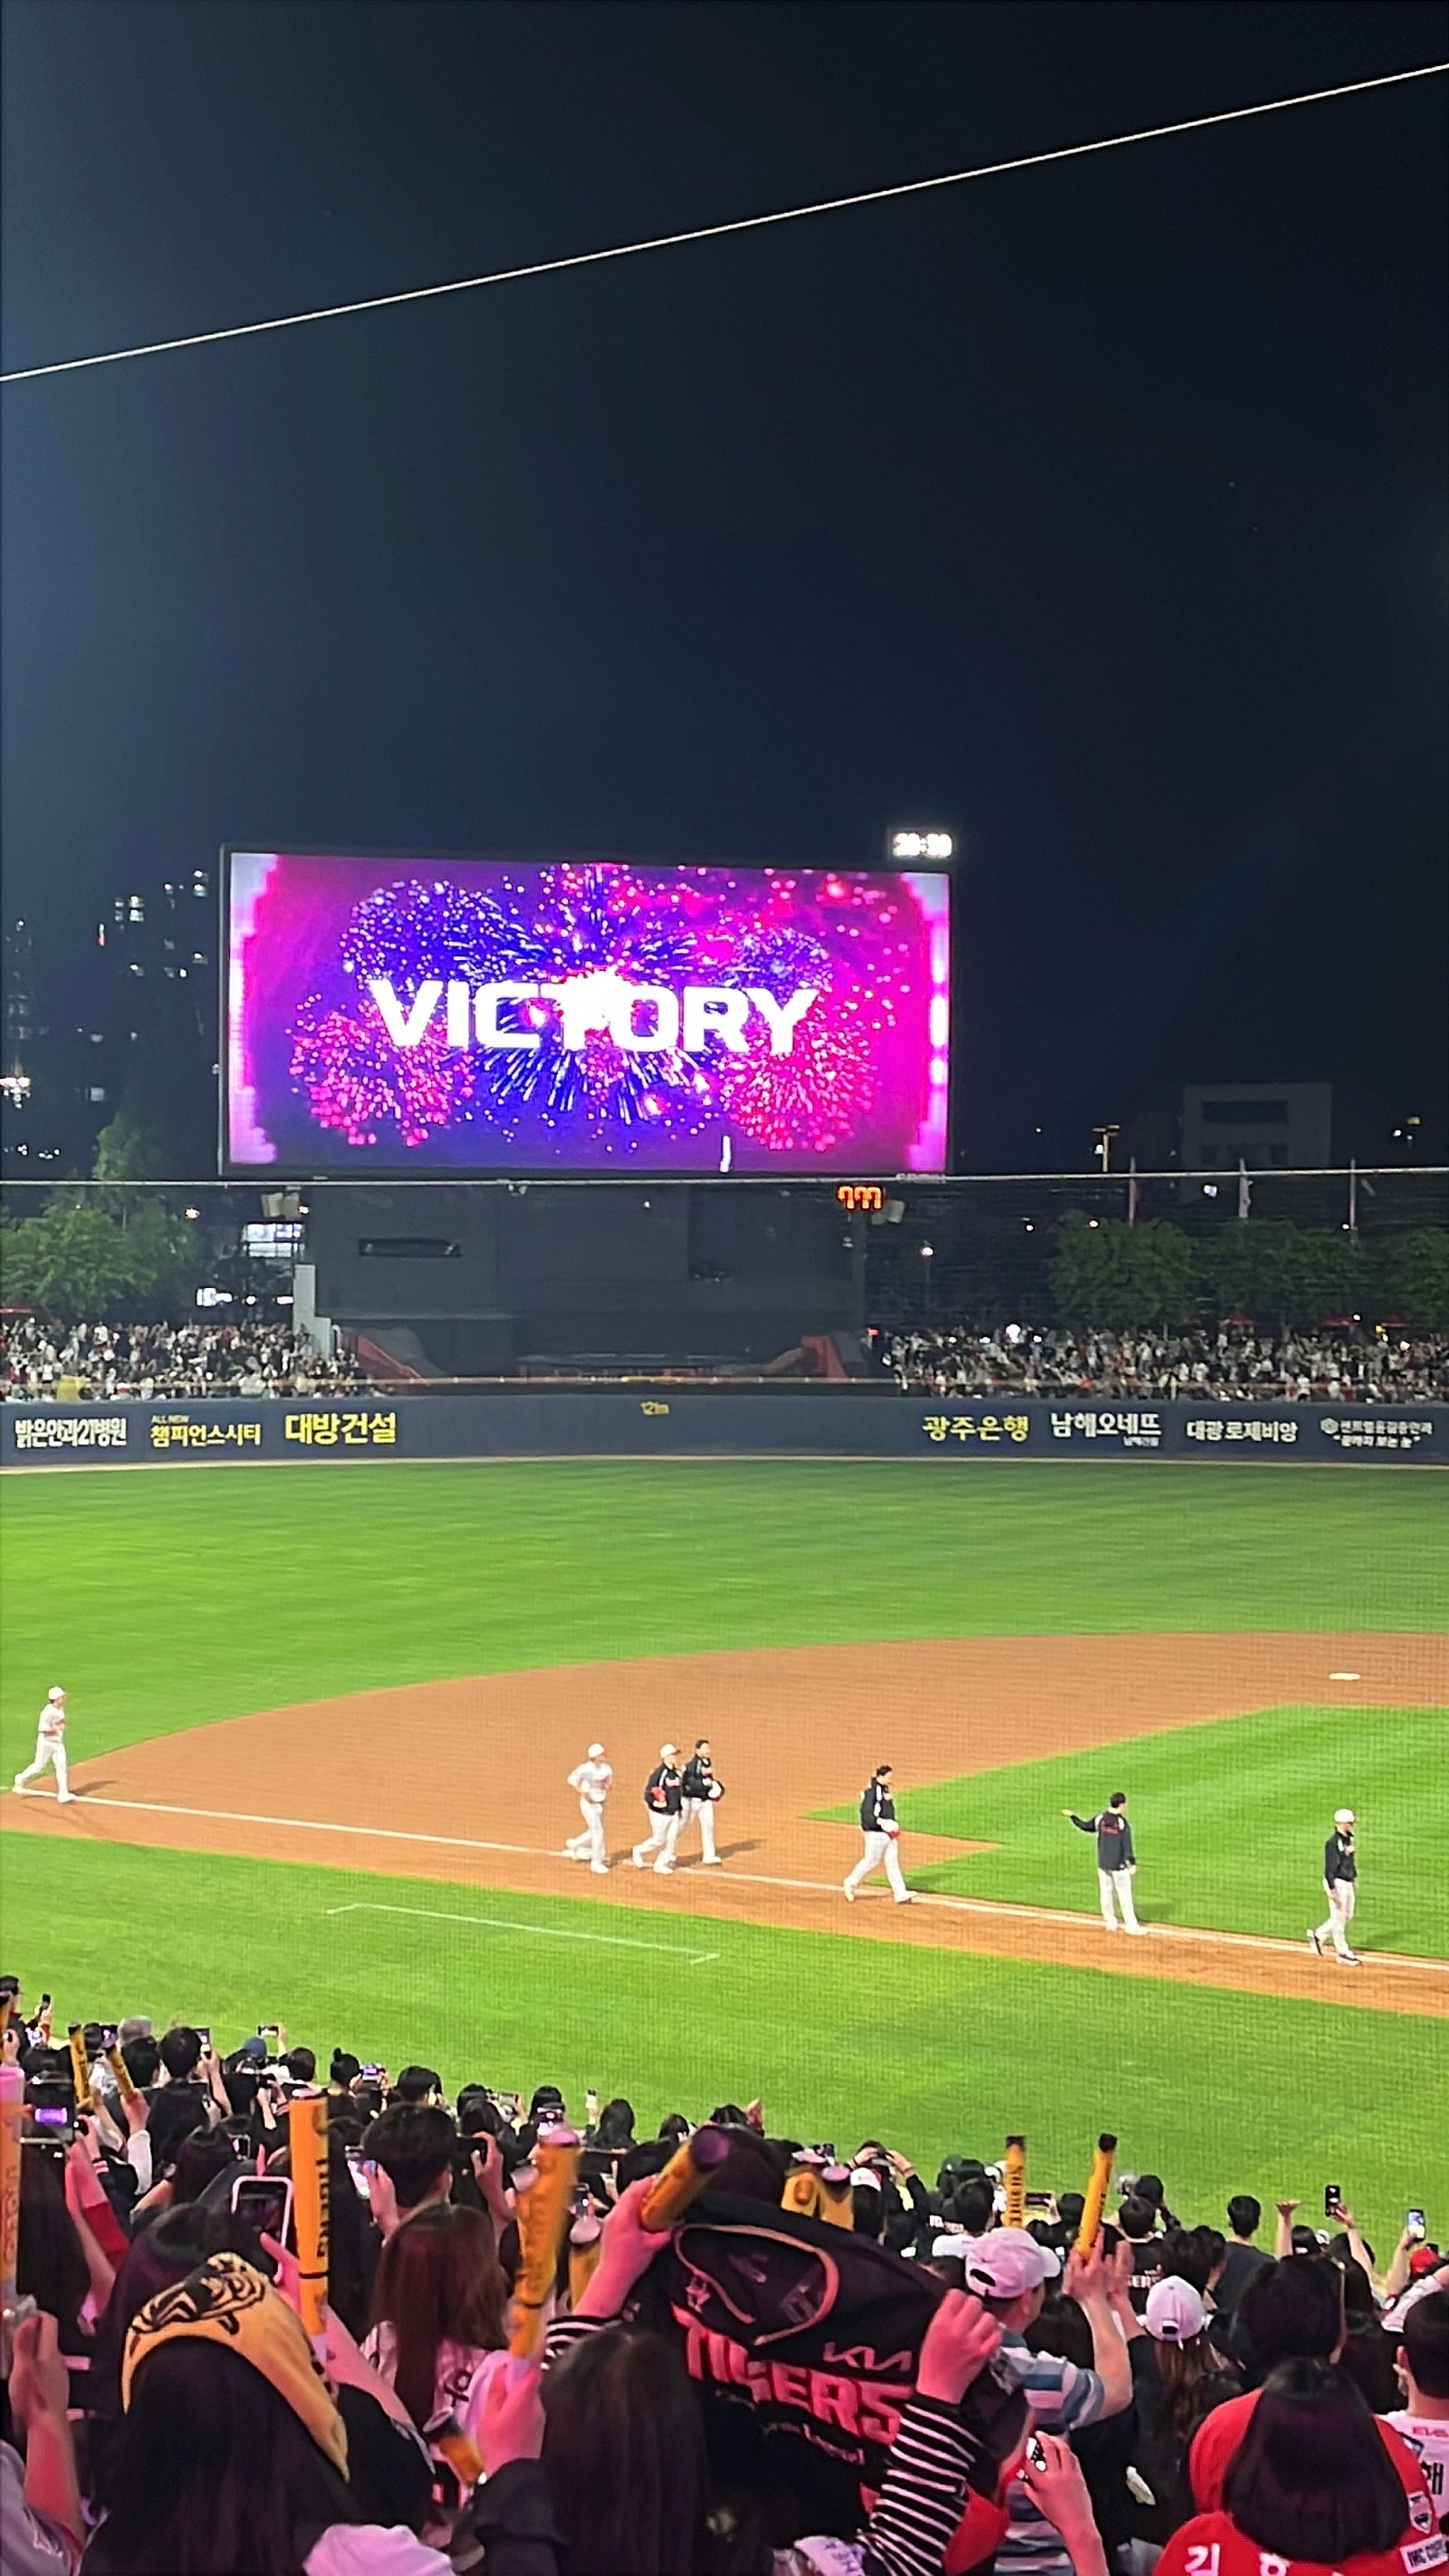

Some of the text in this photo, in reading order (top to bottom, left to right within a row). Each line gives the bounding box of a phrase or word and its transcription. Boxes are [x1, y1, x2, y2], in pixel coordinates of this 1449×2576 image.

[369, 978, 819, 1056] VICTORY
[14, 1418, 128, 1449] 밝은안과21병원
[149, 1423, 262, 1448] 챔피언스시티
[284, 1412, 397, 1446] 대방건설
[922, 1415, 1030, 1443] 광주은행
[1050, 1412, 1163, 1438] 남해오네뜨
[1185, 1419, 1300, 1443] 대광로제비앙
[671, 2302, 913, 2446] TIGERS
